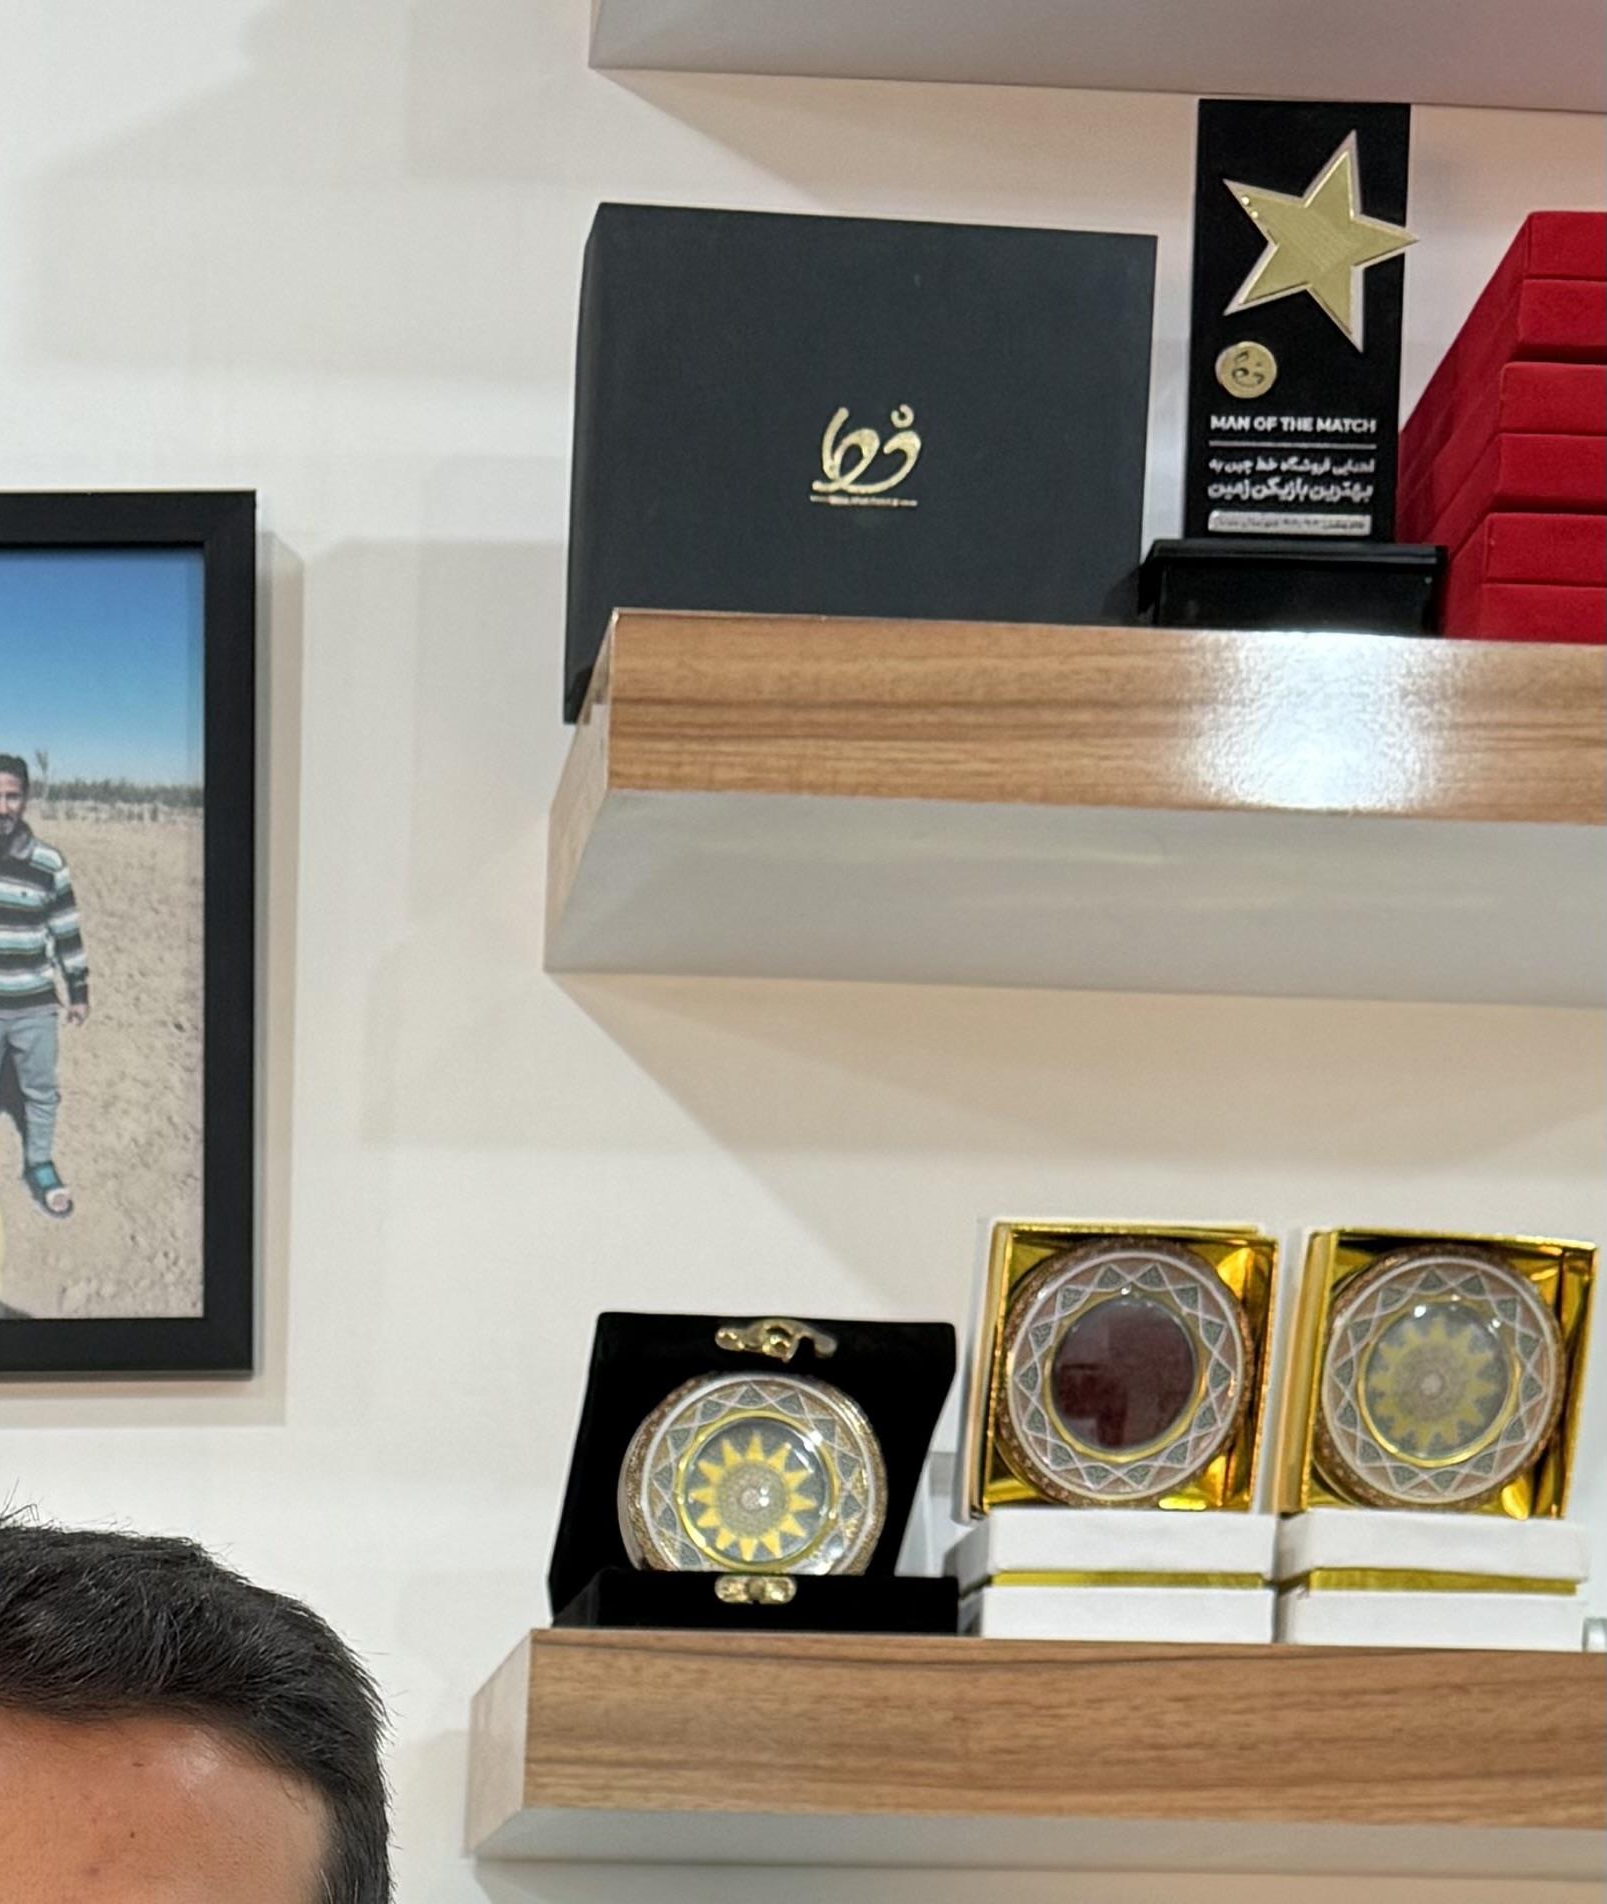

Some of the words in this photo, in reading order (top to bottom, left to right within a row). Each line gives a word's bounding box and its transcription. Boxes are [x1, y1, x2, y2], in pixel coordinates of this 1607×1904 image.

[1210, 414, 1251, 431] MAN
[1253, 415, 1278, 432] OF
[1280, 416, 1314, 433] THE
[1315, 416, 1377, 433] MATCH
[1207, 477, 1251, 501] زمین
[1251, 475, 1309, 502] بازیکن
[1308, 480, 1374, 503] بهترین
